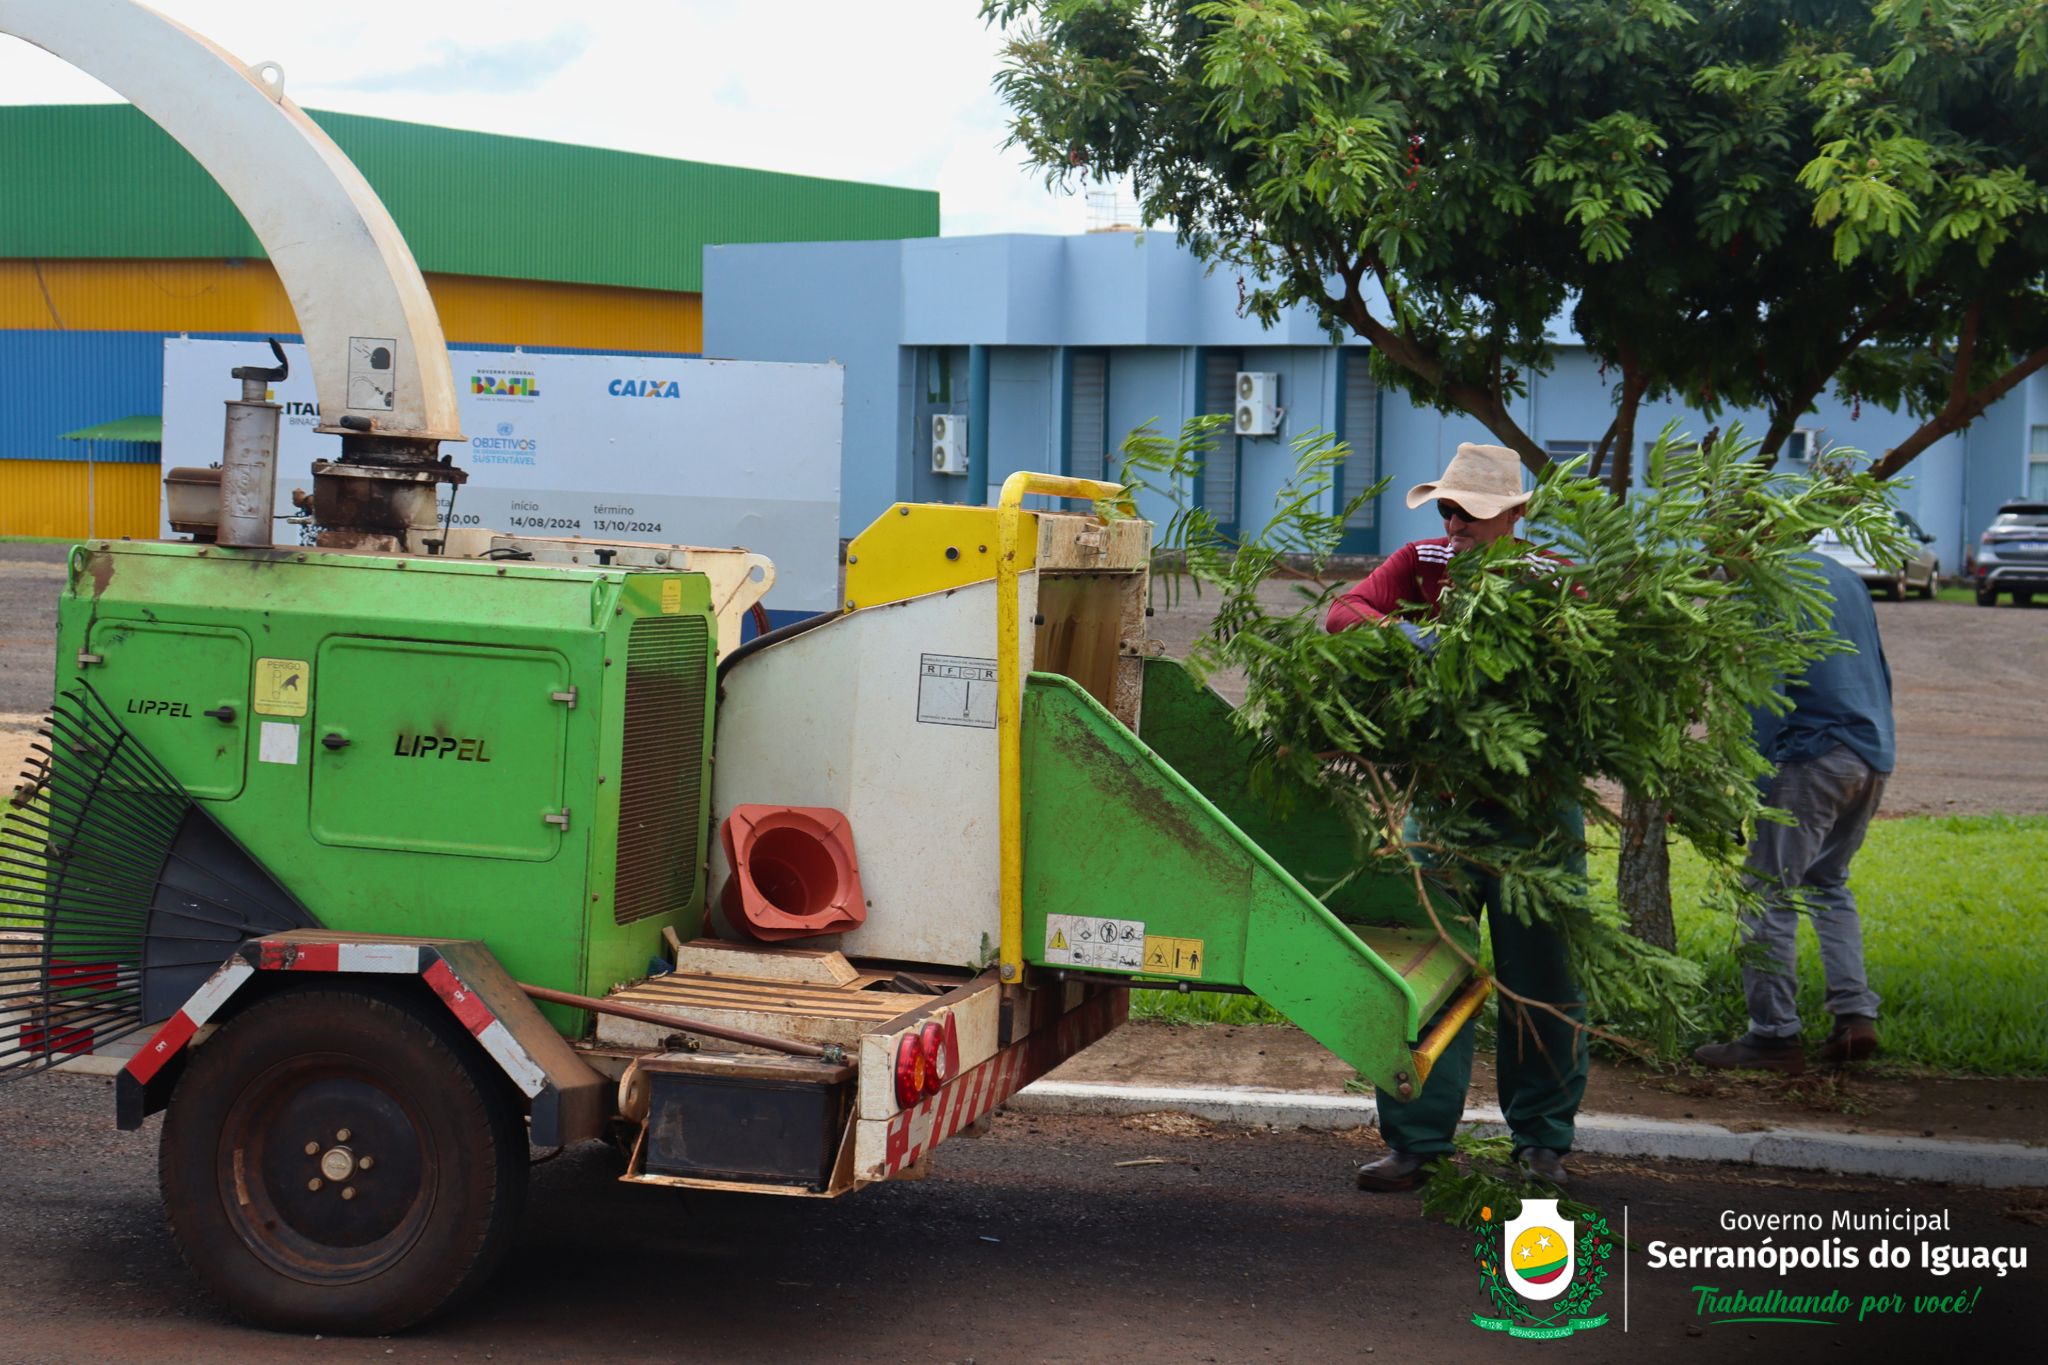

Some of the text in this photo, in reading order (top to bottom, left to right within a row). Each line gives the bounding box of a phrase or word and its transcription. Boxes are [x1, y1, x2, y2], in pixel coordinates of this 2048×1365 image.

[471, 376, 540, 396] BRASIL
[608, 379, 680, 398] CAIXA
[286, 402, 320, 416] ITAI
[472, 437, 536, 450] OBJETIVOS
[511, 501, 539, 511] início
[594, 504, 634, 516] término
[436, 513, 661, 532] 980,00 14/08/2024 13/10/2024
[127, 699, 192, 718] LIPPEL
[394, 735, 491, 762] LIPPEL
